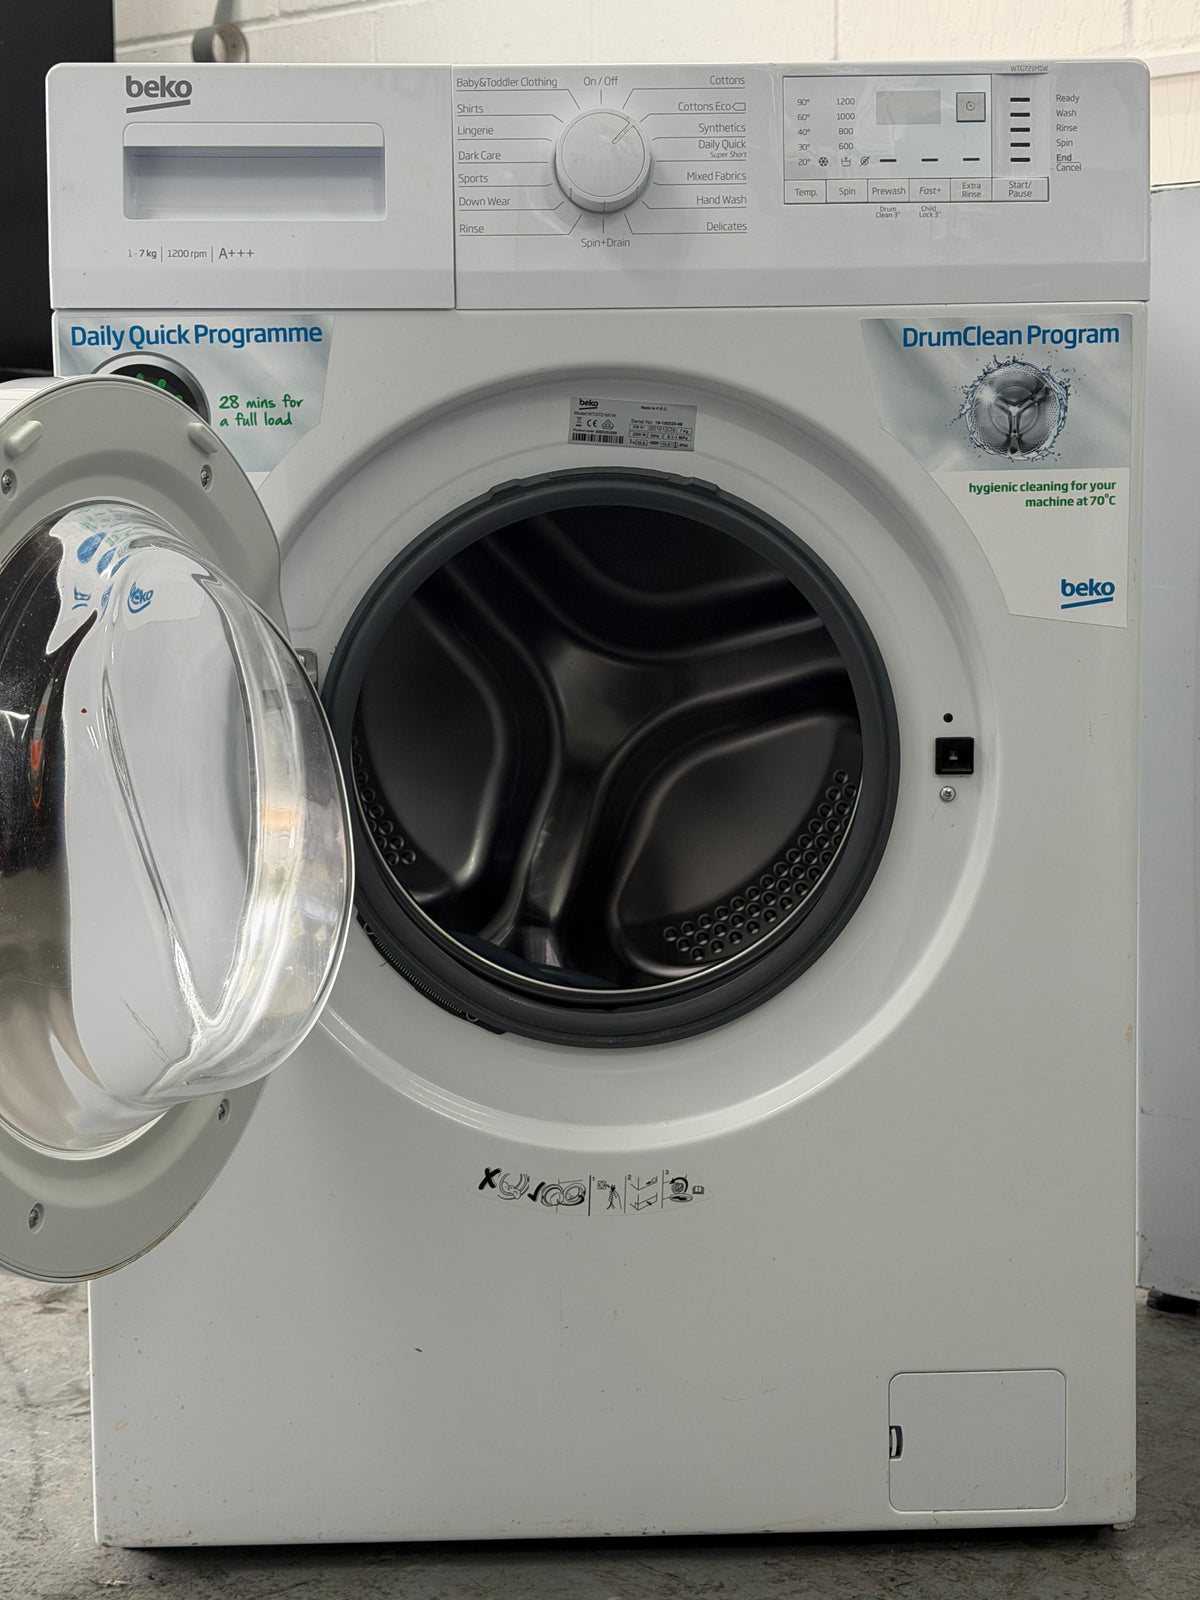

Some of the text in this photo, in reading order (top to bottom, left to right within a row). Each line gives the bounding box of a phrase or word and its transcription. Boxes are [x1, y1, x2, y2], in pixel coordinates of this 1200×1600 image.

[456, 77, 558, 89] Baby&Toddler Clothing
[583, 76, 596, 86] On
[604, 76, 619, 86] Off
[709, 75, 746, 85] Cottons
[126, 76, 192, 98] beko
[1055, 94, 1080, 104] Ready
[456, 104, 484, 113] Shirts
[678, 102, 732, 111] Cottons Eco
[457, 126, 494, 137] Lingerie
[698, 123, 746, 134] Synthetics
[1056, 124, 1078, 132] Rinse
[698, 139, 746, 150] Daily Quick
[1056, 139, 1073, 148] Spin
[458, 151, 501, 160] Dark Care
[1056, 163, 1082, 172] Cancel
[458, 174, 489, 184] Sports
[687, 171, 747, 181] Mixed Fabrics
[1008, 181, 1032, 189] Start/
[795, 188, 818, 198] Temp.
[839, 187, 856, 196] Spin
[872, 187, 906, 195] Prewash
[919, 186, 942, 195] Fast+
[962, 190, 981, 198] Rinse
[458, 197, 511, 206] Down Wear
[696, 195, 747, 204] Hand Wash
[459, 224, 485, 233] Rinse
[706, 222, 747, 231] Delicates
[581, 238, 631, 249] Spin+Drain
[146, 249, 157, 260] kg
[168, 250, 189, 258] 1200
[190, 251, 207, 260] rpm
[218, 248, 255, 259] A+++
[71, 324, 323, 350] Daily Quick Programme
[903, 325, 1120, 349] DrumClean Program
[218, 393, 304, 409] 28 mins for
[219, 412, 293, 426] a full load
[969, 480, 1116, 495] hygienic cleaning for your
[1025, 494, 1116, 507] machine at 70°C
[1061, 578, 1115, 597] beko
